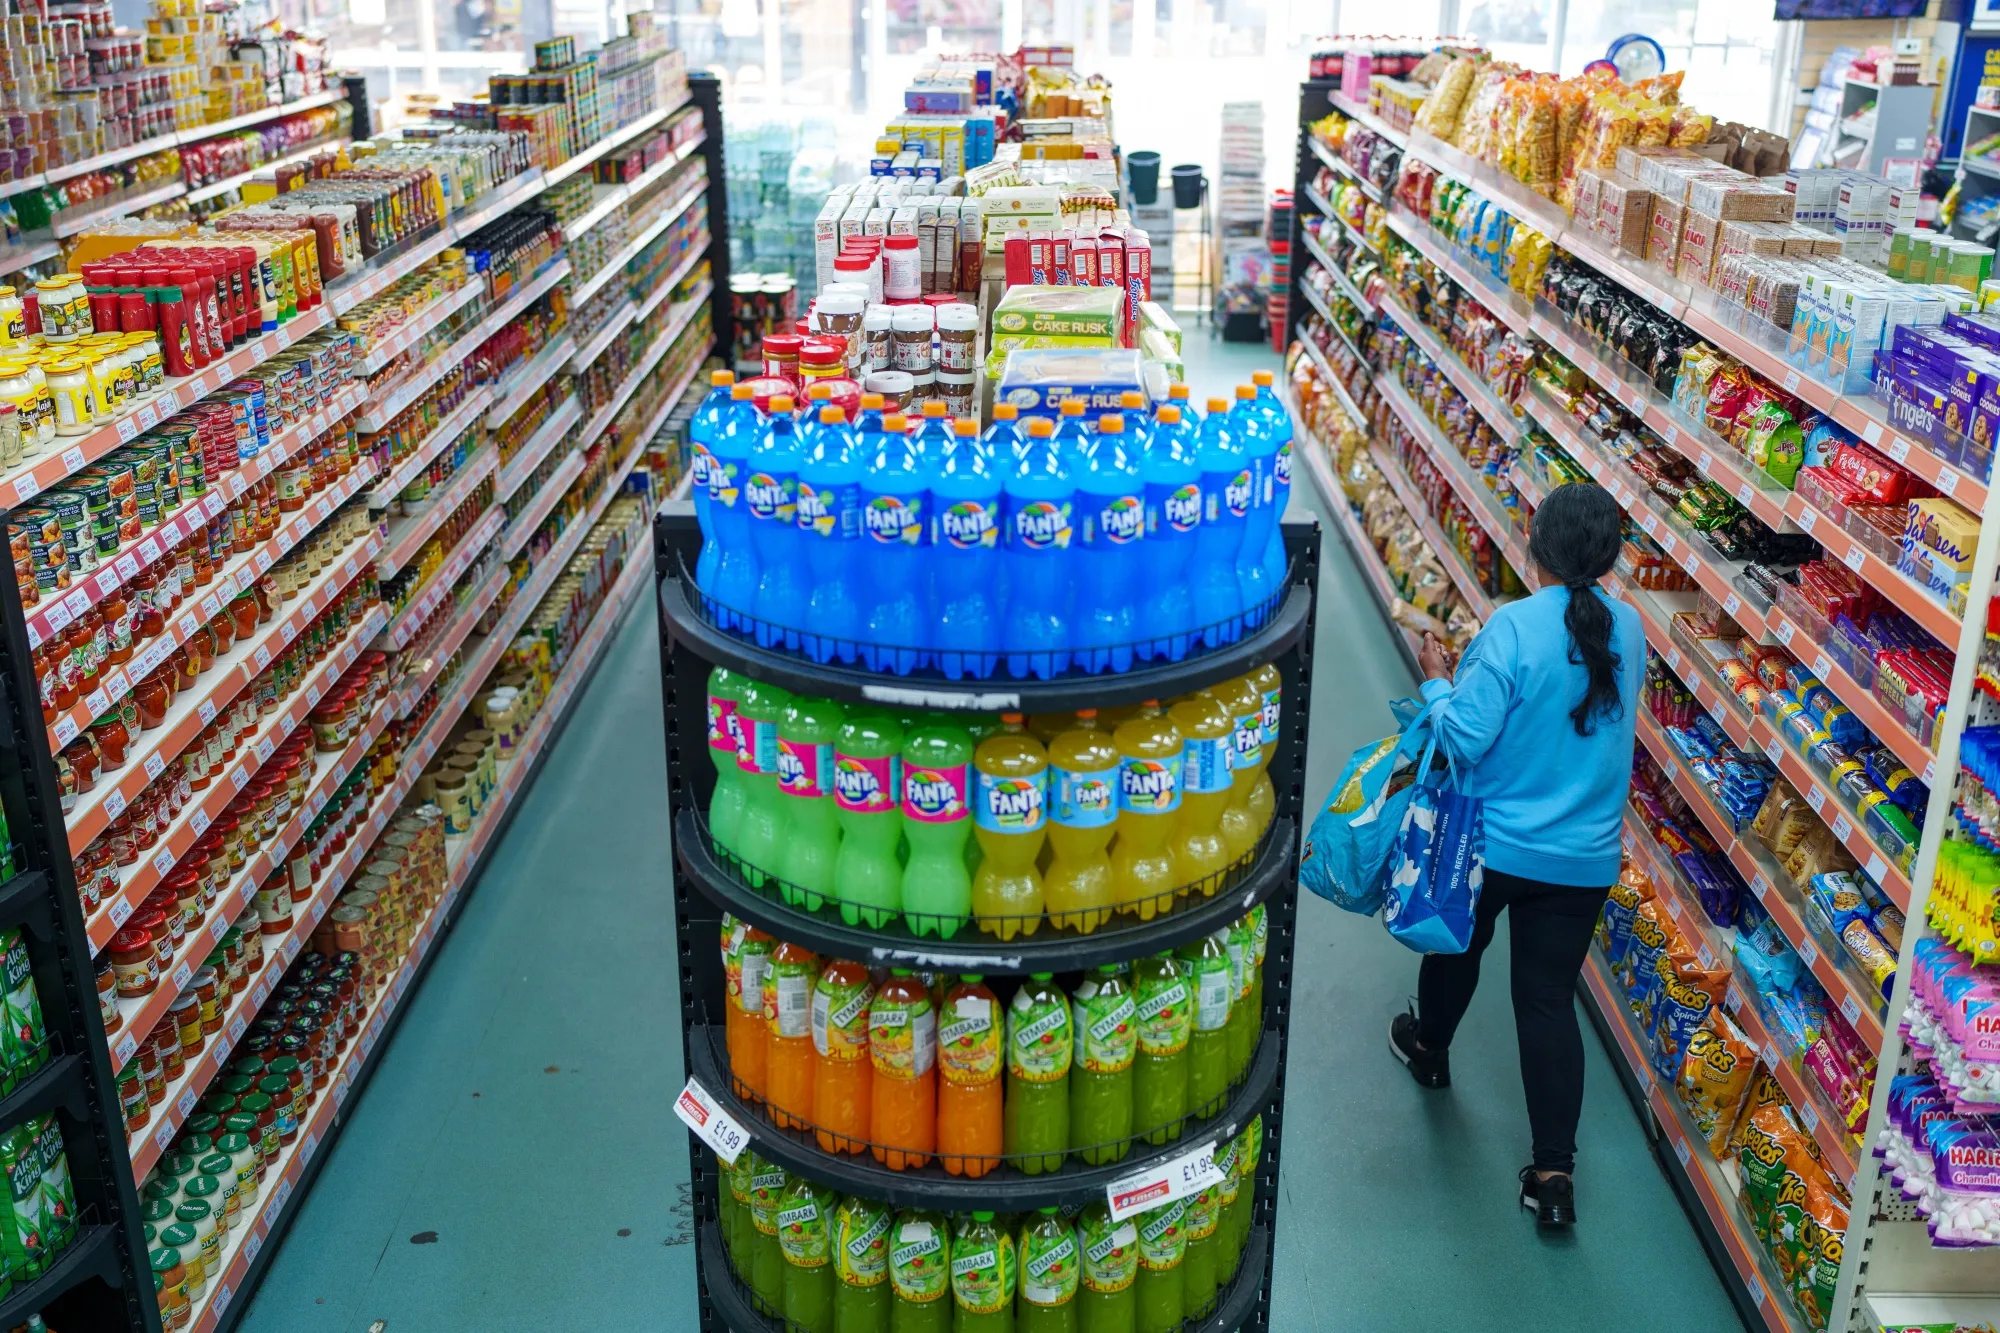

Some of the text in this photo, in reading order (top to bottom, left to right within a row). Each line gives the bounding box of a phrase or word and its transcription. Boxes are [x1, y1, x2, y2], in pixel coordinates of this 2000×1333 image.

[1032, 321, 1107, 334] CAKE RUSK
[1092, 395, 1121, 408] RUS
[1950, 384, 1972, 404] COOKIES
[709, 468, 731, 488] NTA
[746, 481, 789, 504] FANTA
[1225, 482, 1251, 508] FAN
[798, 495, 828, 517] NTA
[865, 505, 916, 529] FANTA
[943, 511, 994, 536] FANTA
[1016, 511, 1068, 536] FANTA
[1101, 506, 1144, 532] FANT
[1880, 660, 1908, 694] WAGON
[1877, 676, 1906, 709] WHEELS
[1235, 727, 1262, 750] FAN
[776, 753, 805, 775] NTA
[906, 777, 957, 802] FANTA
[1121, 770, 1175, 794] FANTA
[988, 788, 1043, 815] FANTA
[1075, 787, 1110, 804] FANTA
[1441, 813, 1450, 834] FROM
[1454, 833, 1468, 870] RECYCLED
[1450, 872, 1460, 890] 100%
[1609, 884, 1640, 911] eetos
[1634, 916, 1666, 948] eetos
[6, 942, 27, 971] Aloe
[8, 958, 31, 985] King
[1137, 988, 1185, 1018] TYMBARK
[870, 1012, 906, 1025] MBARK
[940, 1017, 990, 1041] TYMBARK
[1018, 1011, 1066, 1044] TYMBARK
[1086, 1059, 1102, 1071] 2L
[279, 1102, 295, 1117] DOL
[40, 1121, 60, 1152] Aloe
[713, 1120, 741, 1150] £1.99
[42, 1135, 64, 1164] King
[13, 1150, 39, 1182] Aloe
[1182, 1154, 1215, 1182] £1.99
[1749, 1159, 1768, 1175] Green
[1750, 1171, 1768, 1186] onion
[15, 1165, 42, 1195] King
[1143, 1204, 1184, 1238] TYMBARK
[850, 1215, 890, 1253] TYMBARK
[893, 1238, 940, 1265] TYMBARK
[1030, 1241, 1073, 1274] TYMBARK
[846, 1272, 865, 1286] 2L
[1085, 1277, 1102, 1291] 2L
